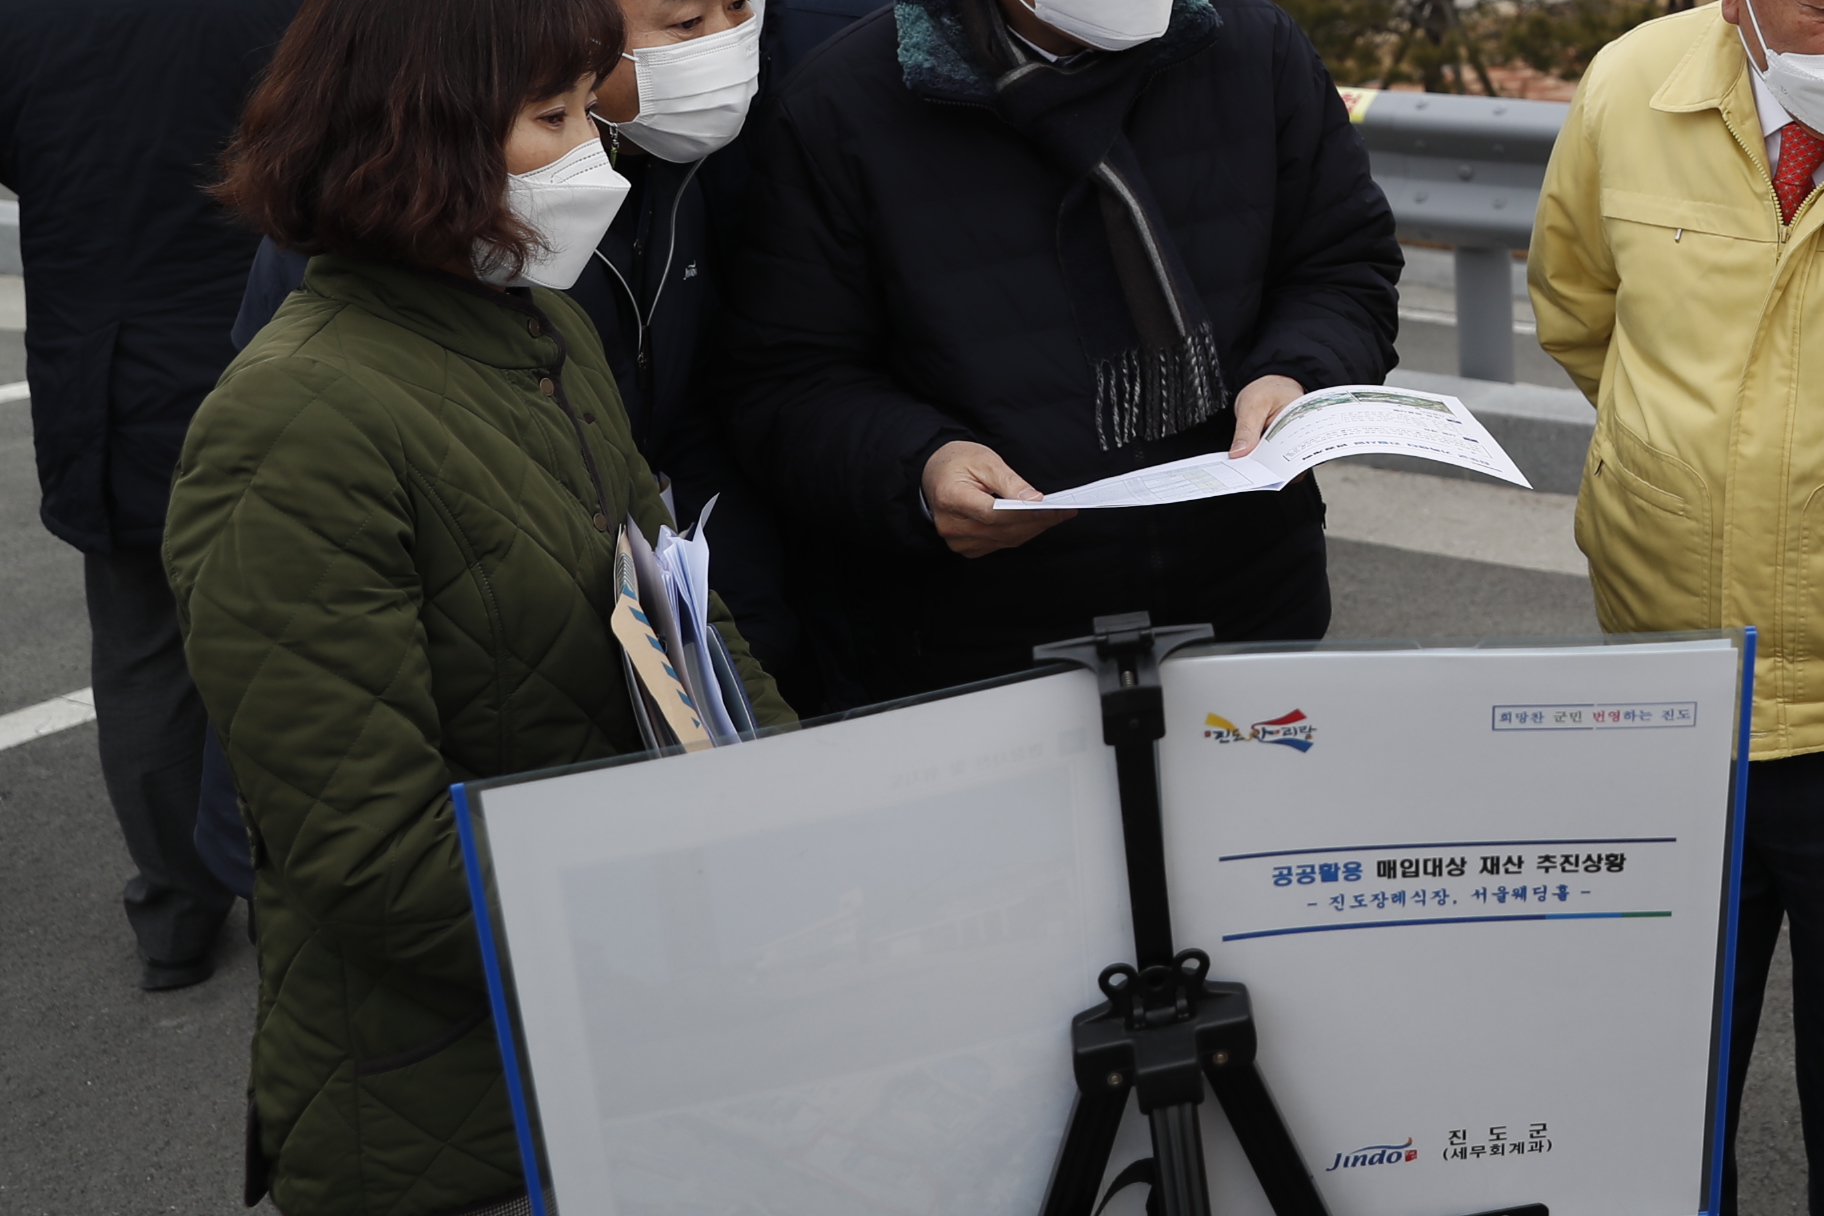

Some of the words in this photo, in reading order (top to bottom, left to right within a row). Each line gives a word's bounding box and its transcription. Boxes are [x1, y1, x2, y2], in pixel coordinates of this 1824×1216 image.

[1554, 710, 1583, 723] 군민
[1662, 708, 1691, 722] 진도
[1272, 860, 1364, 887] 공공활용
[1377, 855, 1468, 880] 매입대상
[1479, 854, 1525, 877] 재산
[1536, 852, 1627, 874] 추진상황
[1470, 883, 1571, 904] 서울웨딩홀
[1325, 1146, 1402, 1171] Jindo
[1443, 1139, 1553, 1161] (세무회계과)
